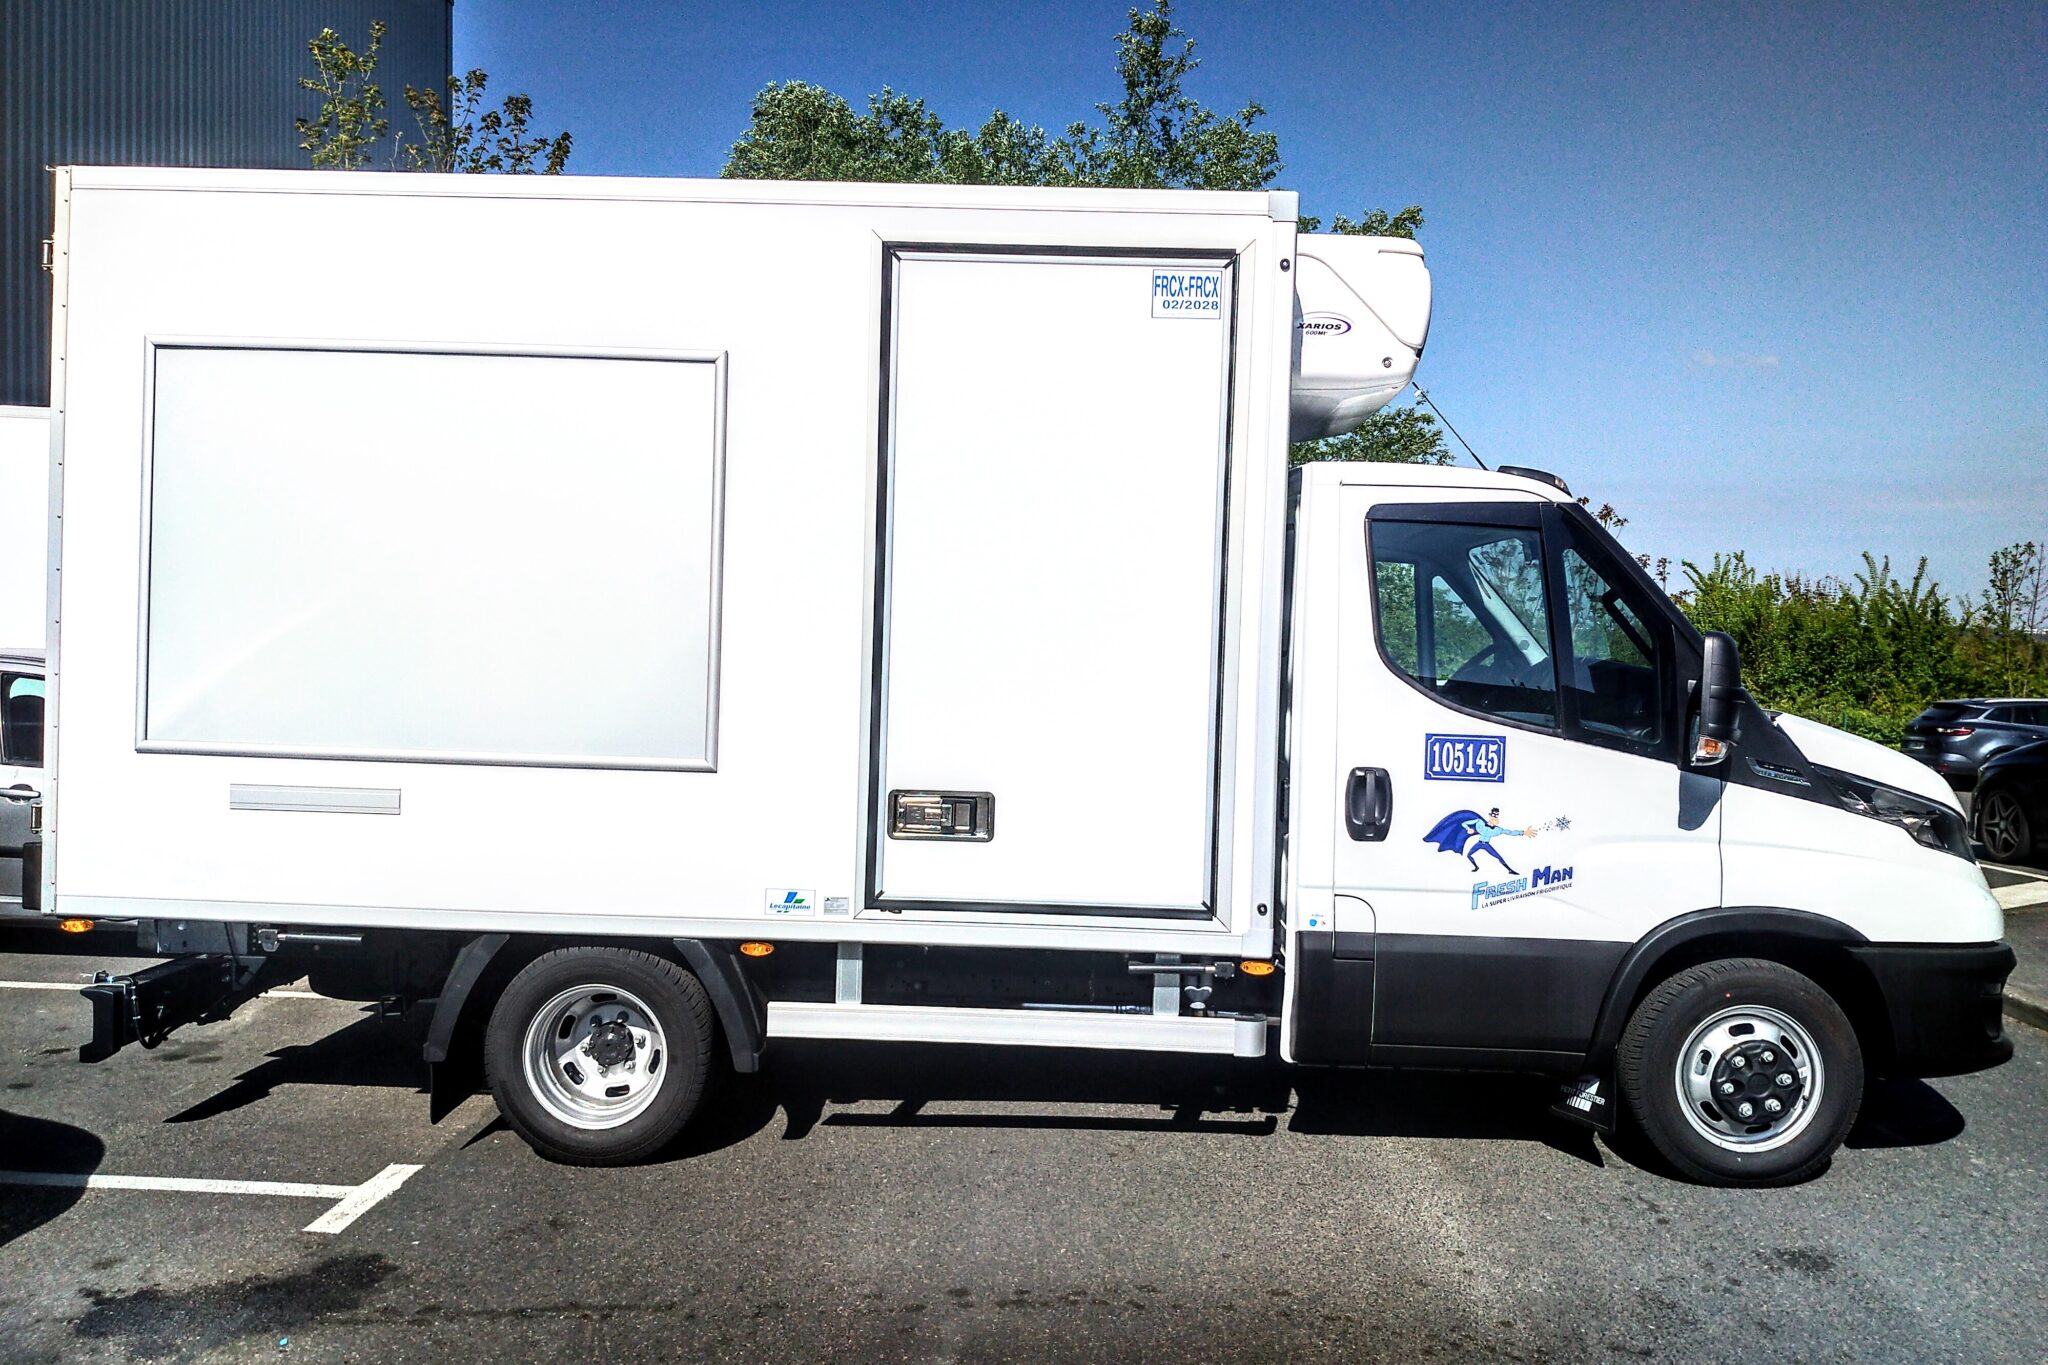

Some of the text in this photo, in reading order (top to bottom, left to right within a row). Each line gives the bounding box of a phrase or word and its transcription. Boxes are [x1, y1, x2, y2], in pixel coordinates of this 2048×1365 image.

[1154, 275, 1219, 298] FRCX-FRCX
[1162, 299, 1219, 310] 02/2028
[1297, 322, 1342, 330] XARIOS
[1432, 741, 1499, 775] 105145
[1481, 882, 1573, 909] LA SUPER LIVRAISON FRIGORIFIQUE
[769, 902, 811, 911] Lecapitaine
